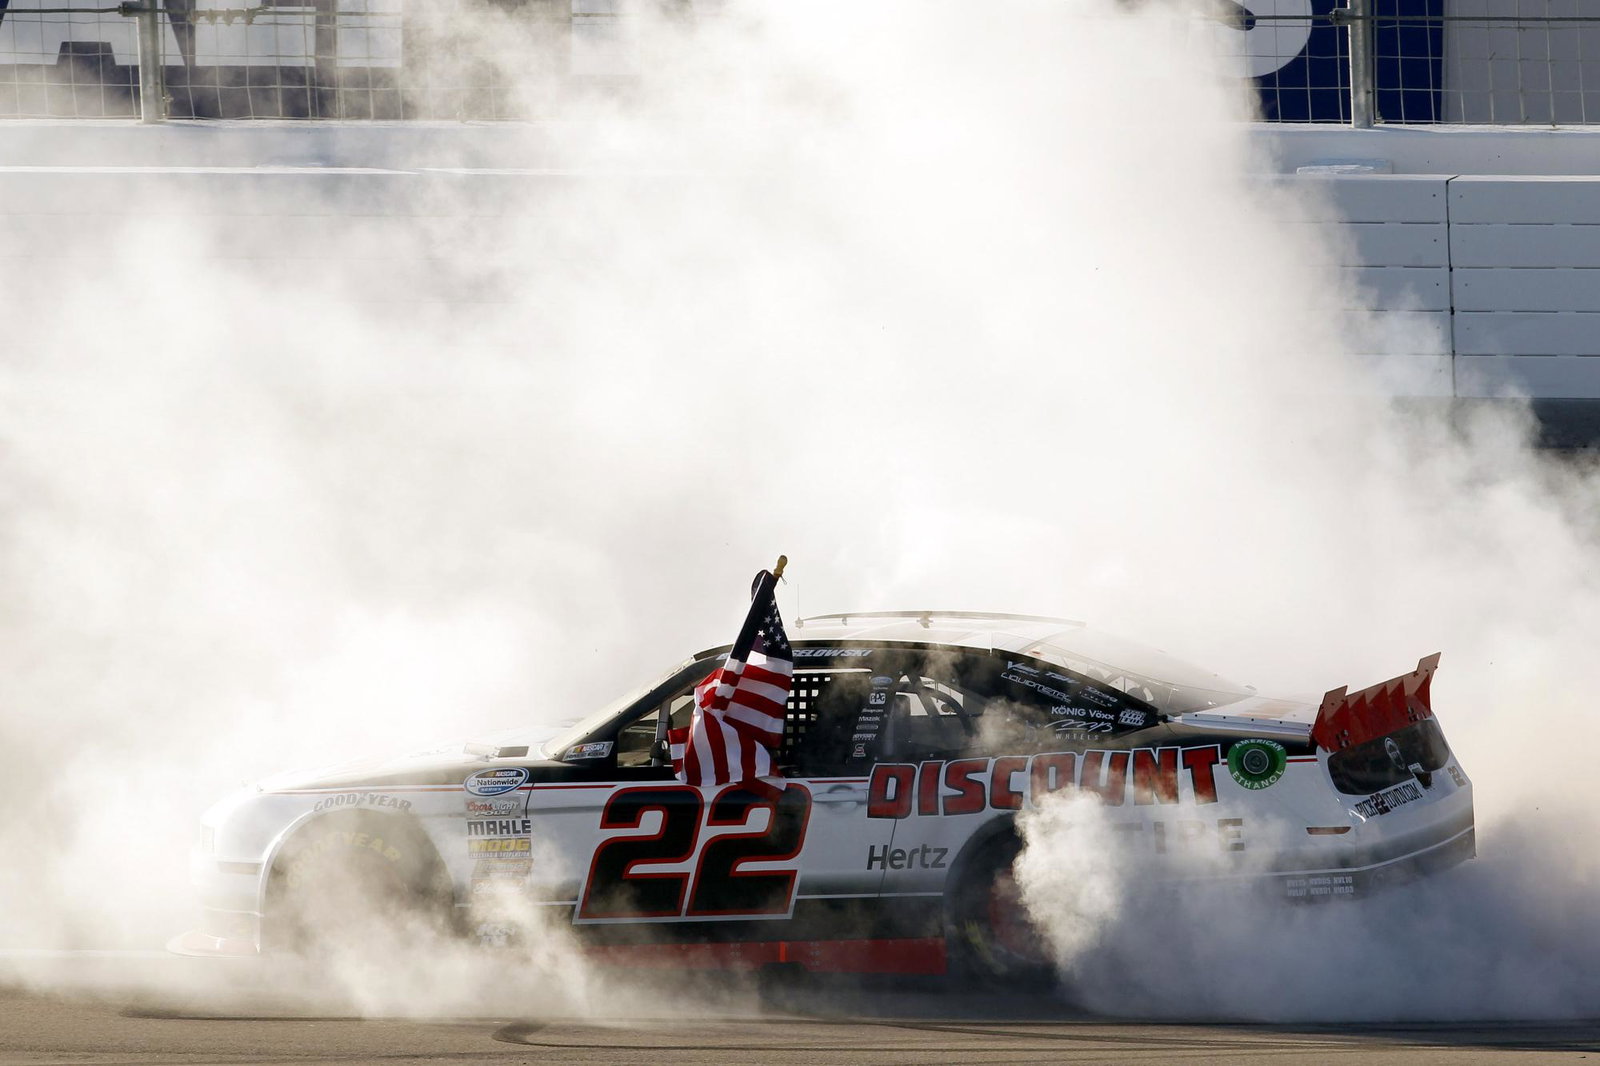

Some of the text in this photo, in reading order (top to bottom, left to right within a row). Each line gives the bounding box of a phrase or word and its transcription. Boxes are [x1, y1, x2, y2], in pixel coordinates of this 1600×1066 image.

[1051, 705, 1087, 716] KÖNIG
[1234, 739, 1284, 751] AMERICAN
[476, 778, 519, 786] Nationwide
[867, 744, 1222, 820] DISCOUNT
[1232, 770, 1284, 789] ETHANOL
[467, 820, 531, 835] MAHLE
[572, 783, 812, 925] 22
[866, 842, 949, 871] Hertz
